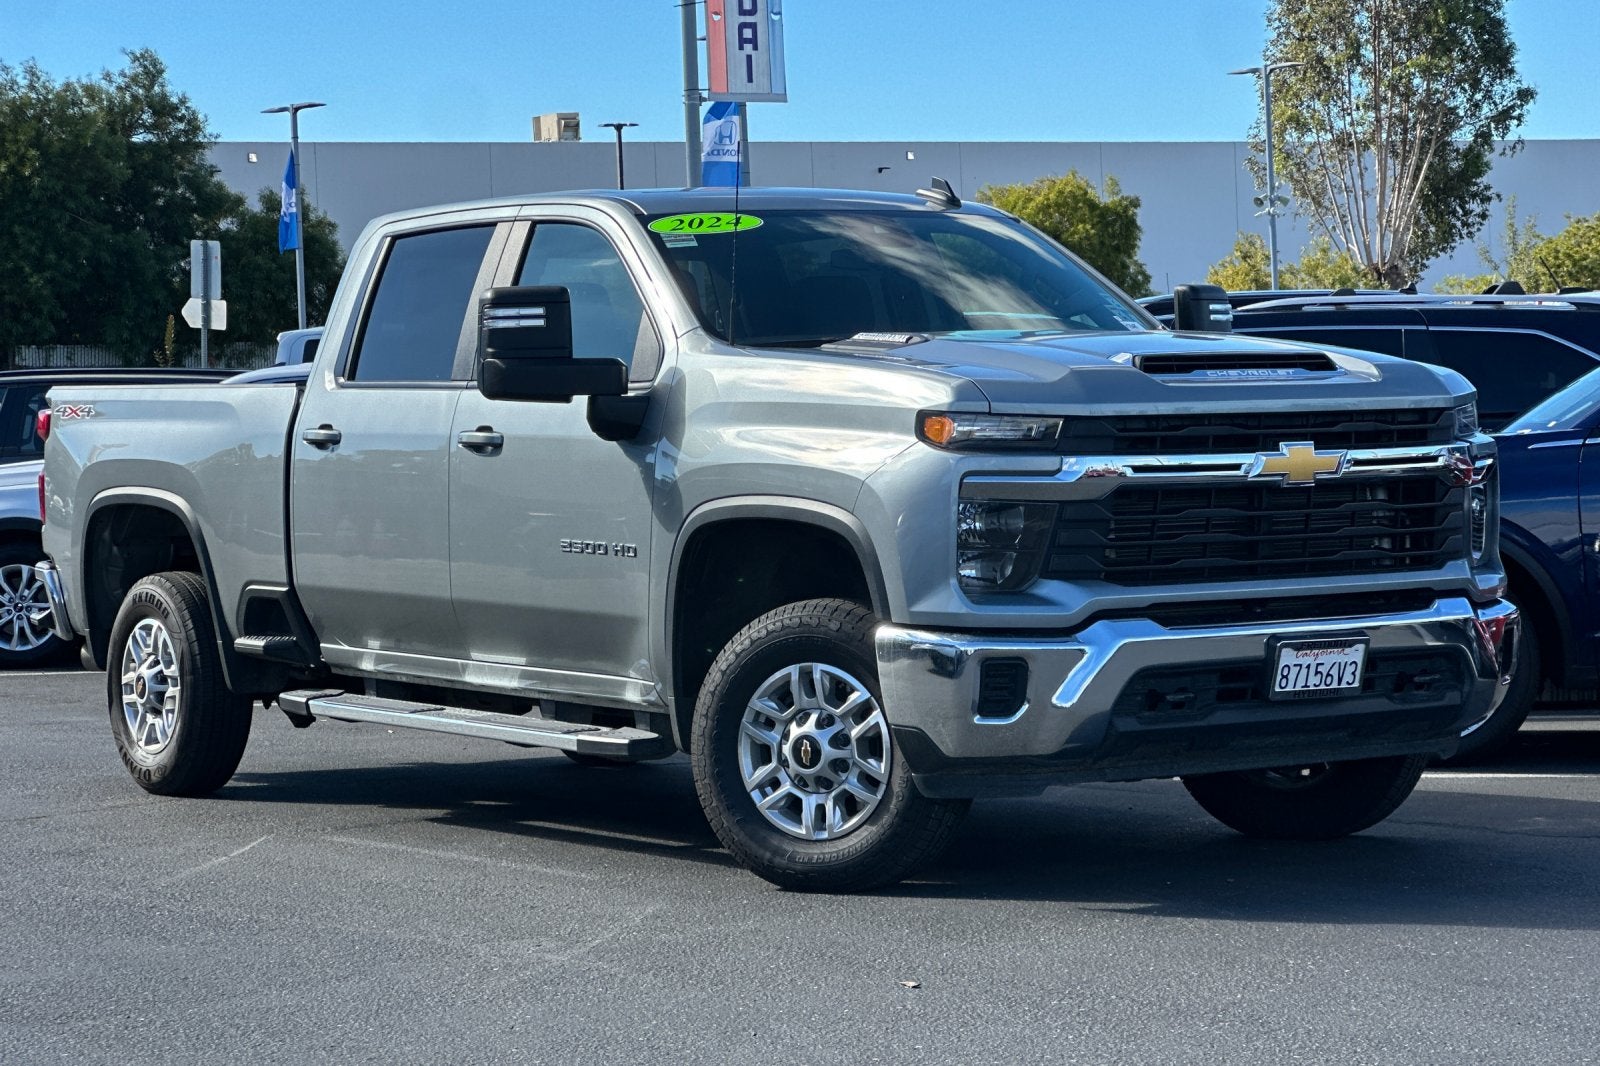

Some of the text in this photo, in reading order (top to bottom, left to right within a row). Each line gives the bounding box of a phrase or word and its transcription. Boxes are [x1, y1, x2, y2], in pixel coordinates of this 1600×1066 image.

[669, 216, 742, 231] 2024
[1206, 369, 1295, 377] CHEVROLET
[612, 542, 637, 558] HD
[1295, 648, 1350, 661] California
[1278, 660, 1358, 690] 87156V3
